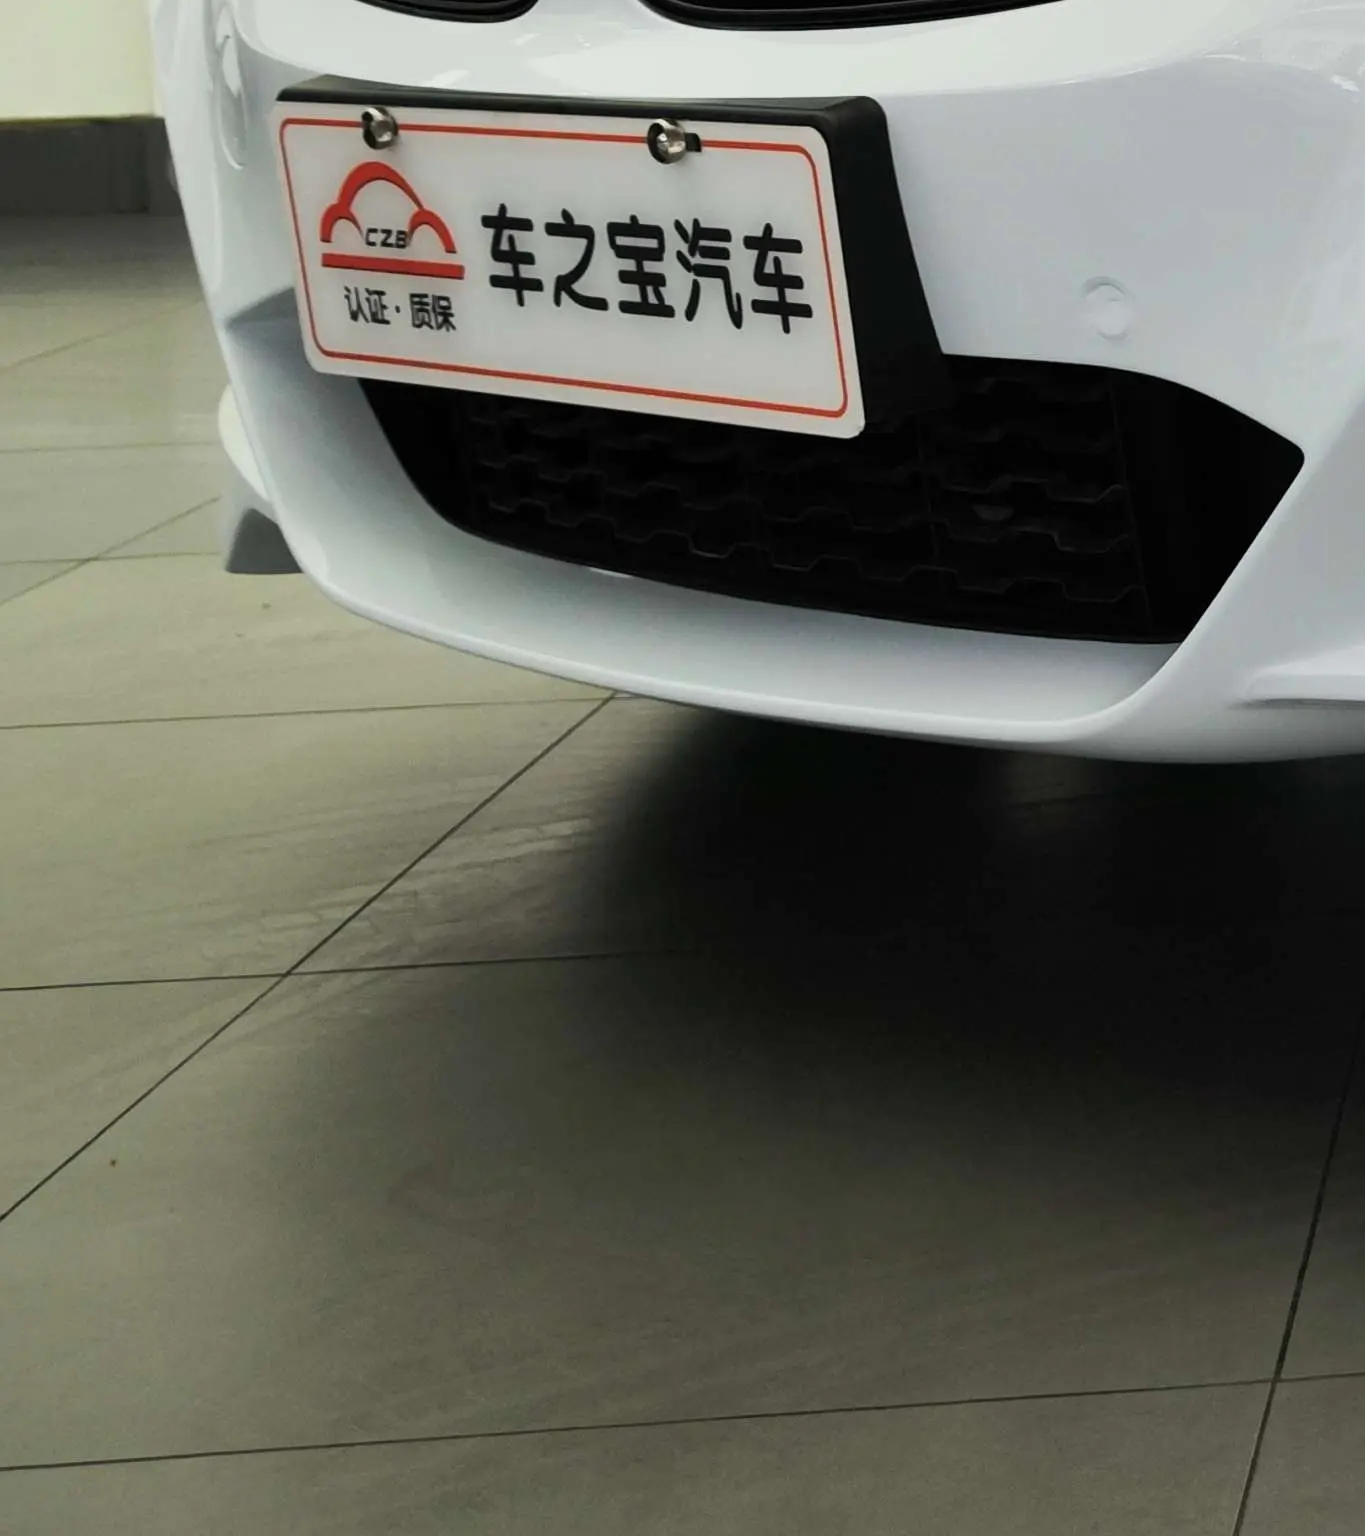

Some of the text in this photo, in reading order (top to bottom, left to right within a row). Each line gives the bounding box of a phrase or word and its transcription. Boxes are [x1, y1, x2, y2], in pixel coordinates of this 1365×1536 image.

[365, 228, 408, 249] CZB
[481, 203, 813, 334] 车之宝汽车
[343, 285, 456, 332] 认证·质保
